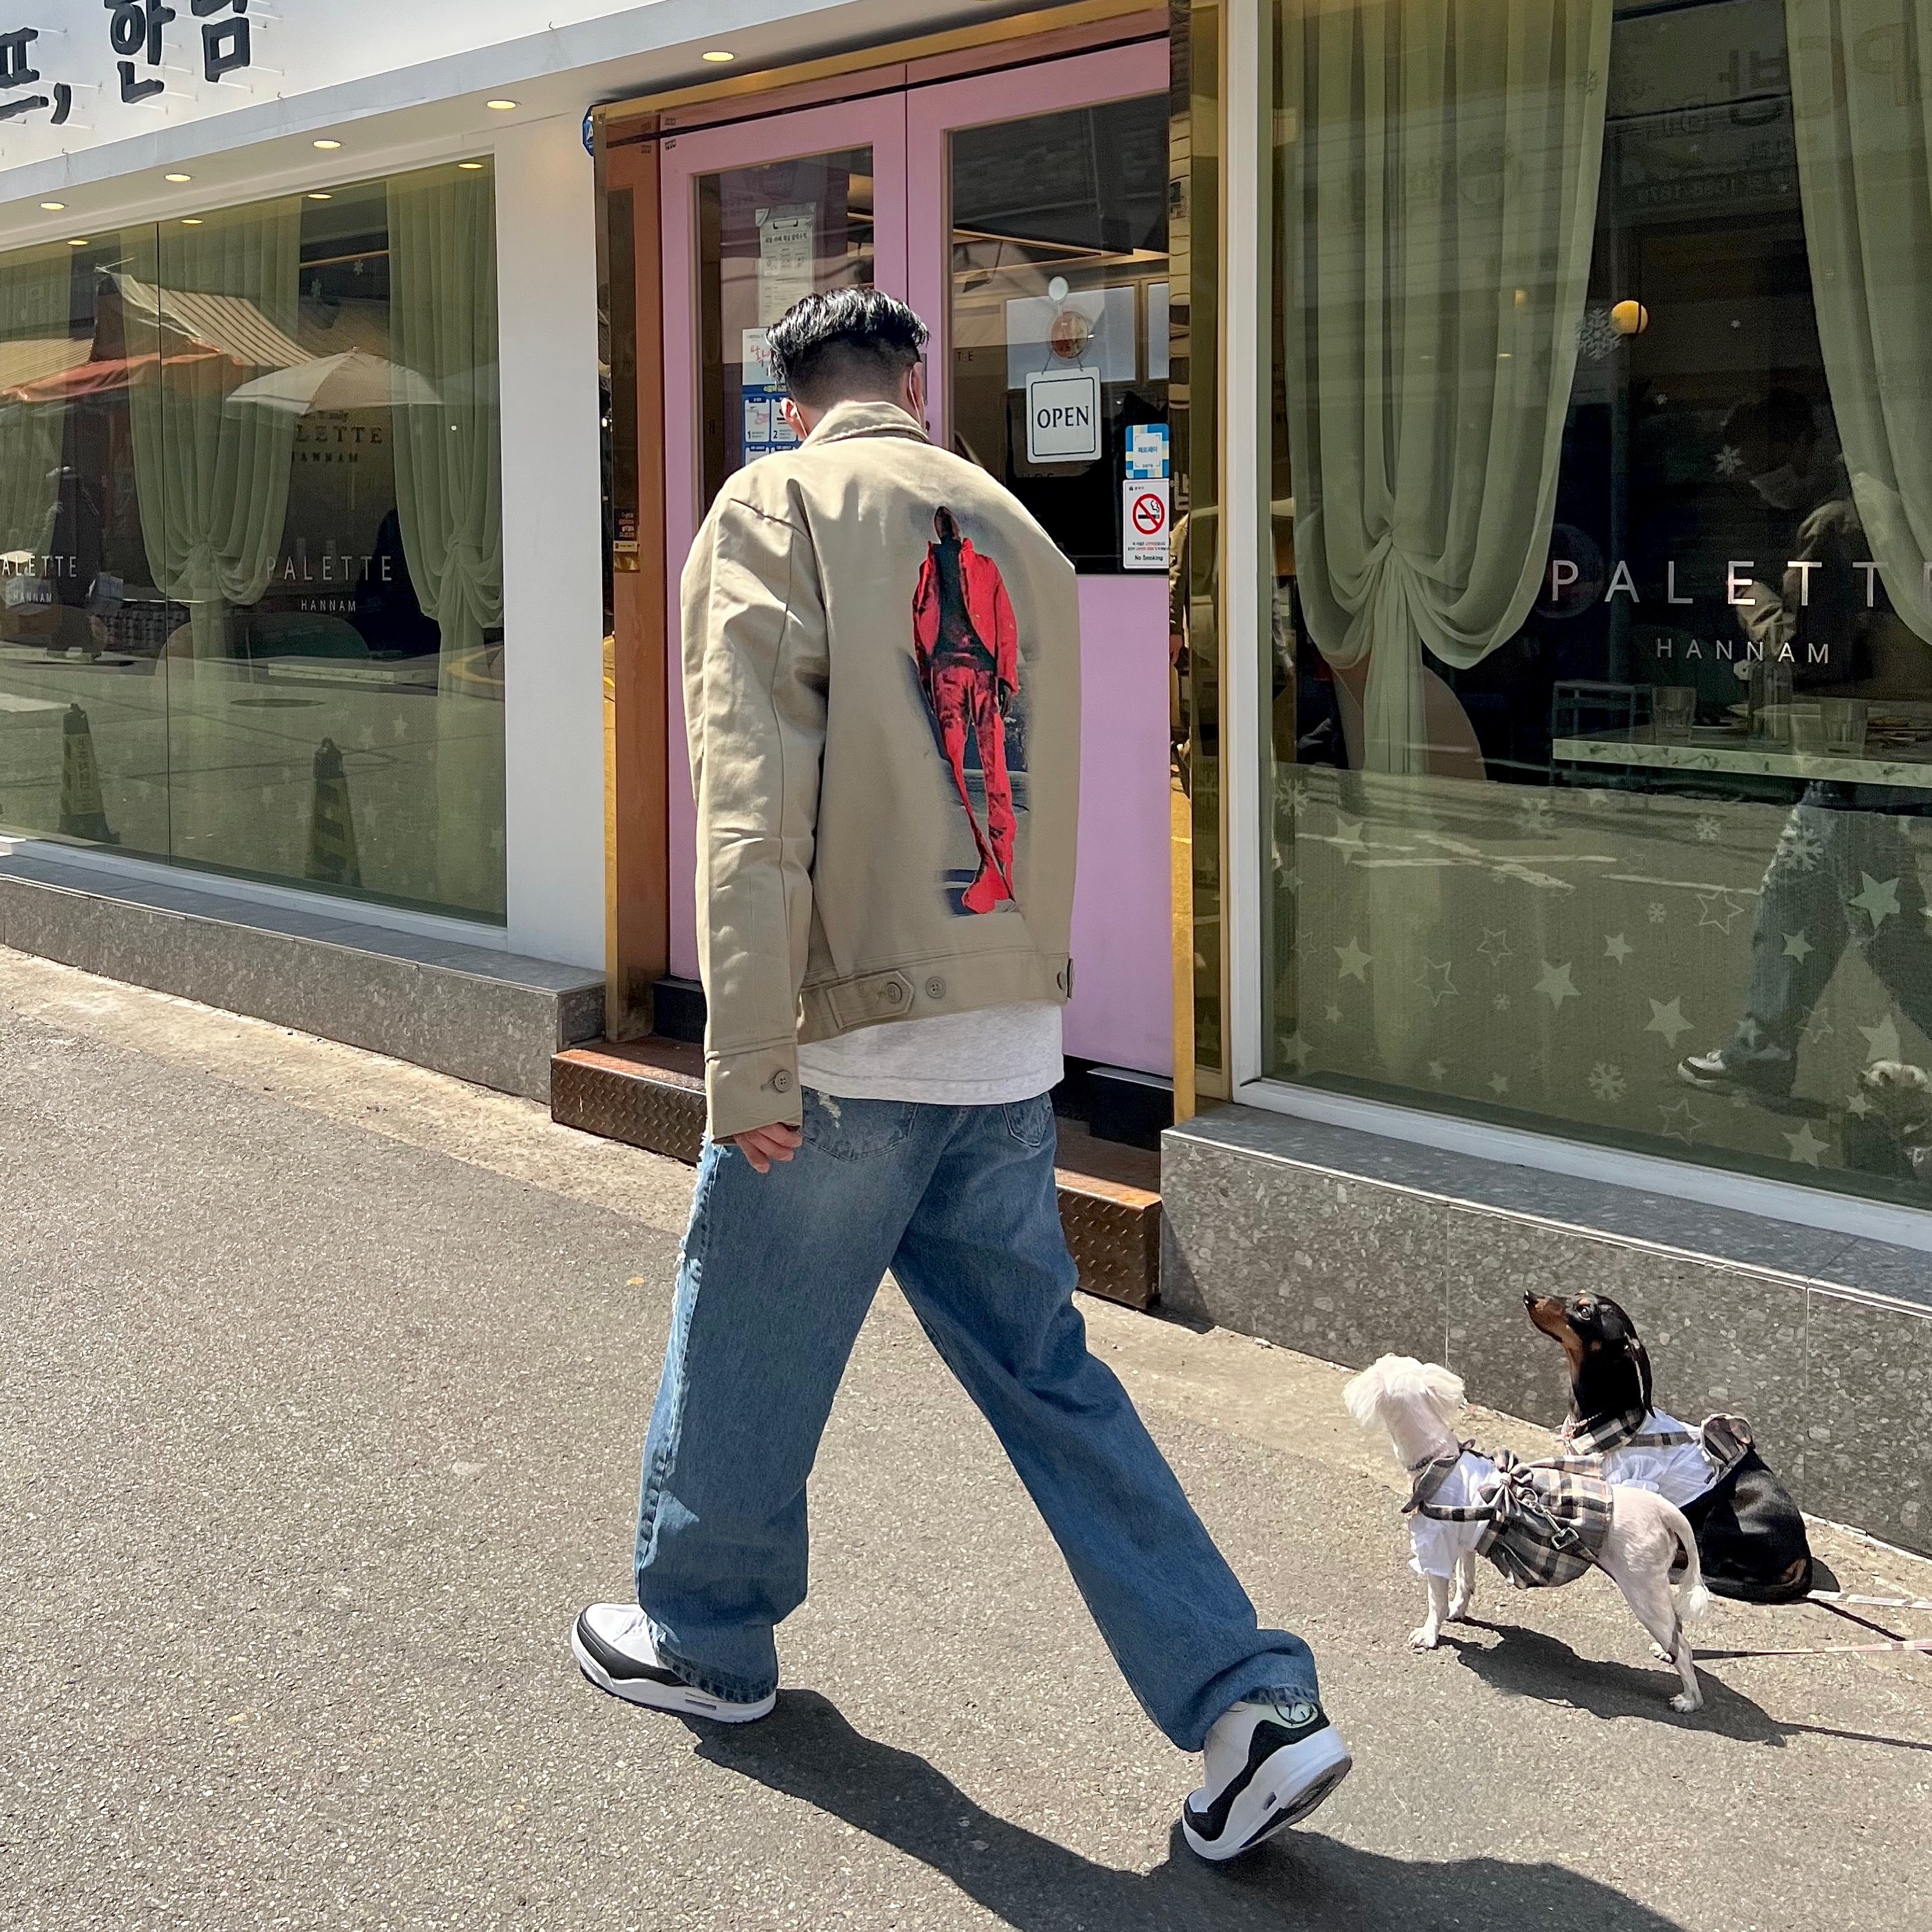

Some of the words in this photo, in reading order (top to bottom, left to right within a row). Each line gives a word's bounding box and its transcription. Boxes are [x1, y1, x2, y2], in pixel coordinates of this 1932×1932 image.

[1037, 406, 1089, 428] OPEN
[266, 556, 392, 581] PALETTE
[301, 599, 356, 613] HANNAM
[1657, 637, 1829, 664] HANNAM
